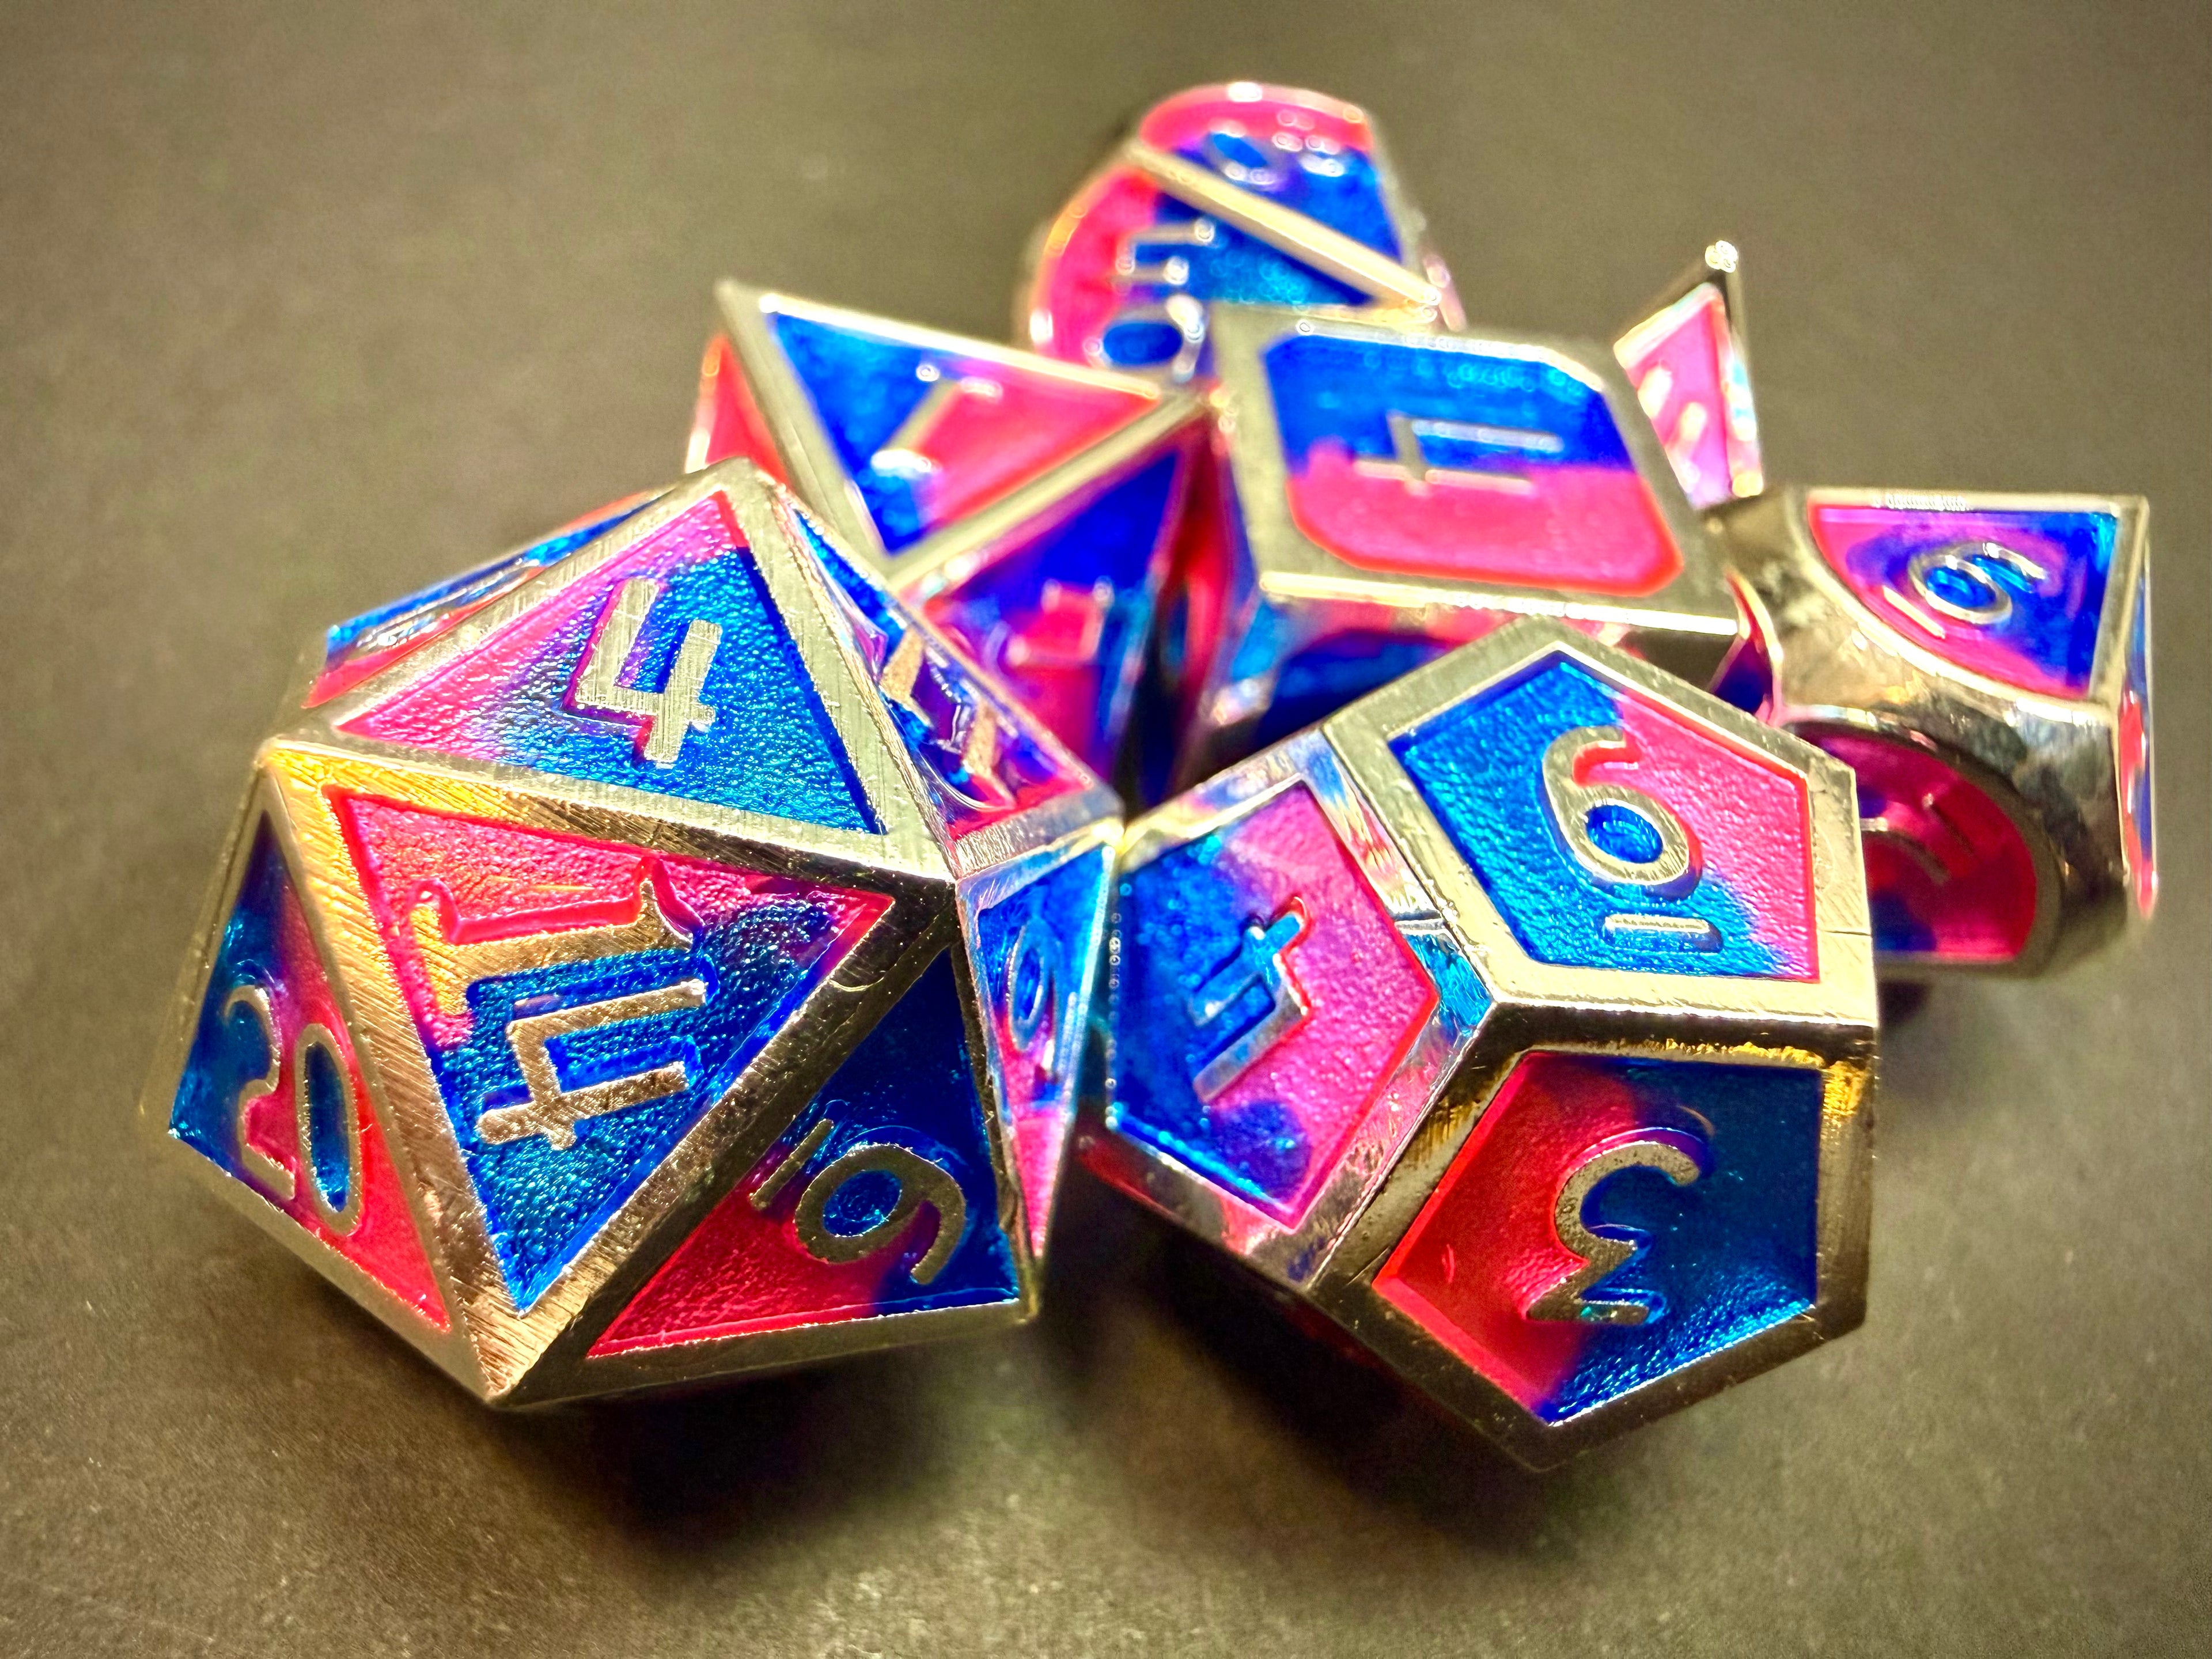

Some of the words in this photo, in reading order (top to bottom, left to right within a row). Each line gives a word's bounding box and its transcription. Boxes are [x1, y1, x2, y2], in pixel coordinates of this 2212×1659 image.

[575, 577, 722, 762] 4
[1543, 725, 1709, 934] 6
[410, 878, 709, 1151] 14
[1188, 911, 1304, 1103] 4
[222, 983, 365, 1233] 20
[1527, 1141, 1700, 1325] 3
